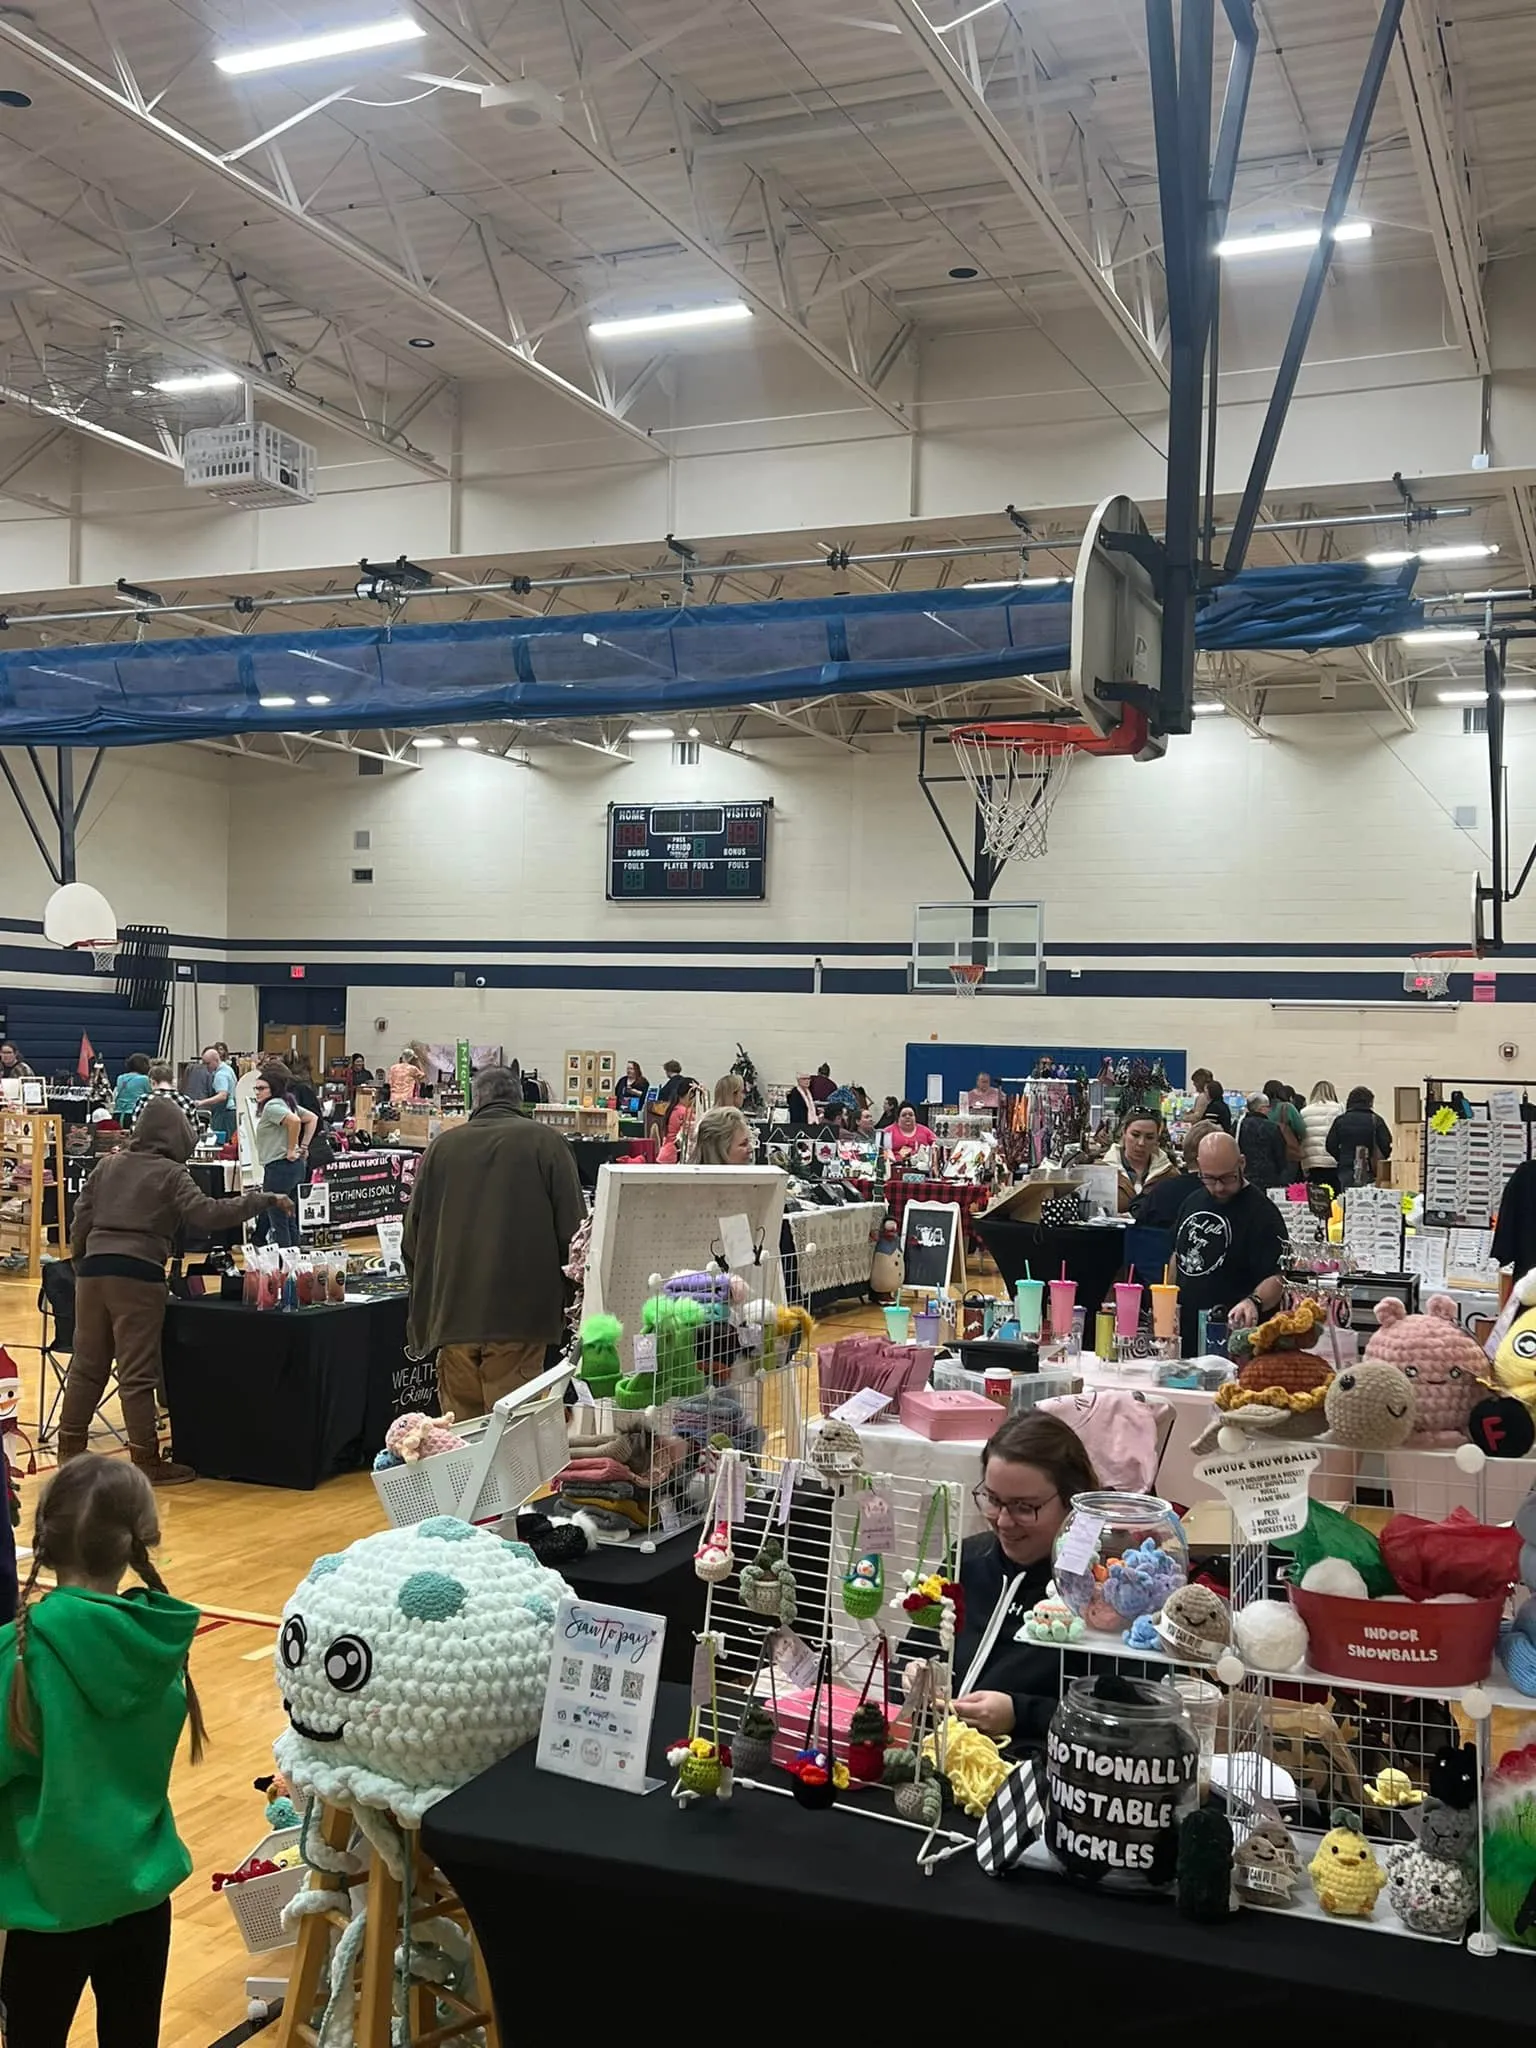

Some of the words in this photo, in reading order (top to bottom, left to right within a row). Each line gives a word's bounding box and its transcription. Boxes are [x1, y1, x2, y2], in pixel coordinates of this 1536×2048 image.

[618, 810, 645, 821] HOME
[726, 807, 762, 819] VISITOR
[627, 849, 650, 857] BONUS
[667, 843, 691, 851] PERIOD
[723, 848, 746, 856] BONUS
[623, 862, 645, 870] FOULS
[663, 862, 688, 870] PLAYER
[693, 862, 714, 870] FOULS
[728, 861, 750, 869] FOULS
[376, 1184, 396, 1196] ONLY
[1482, 1416, 1506, 1451] F
[1249, 1451, 1318, 1469] SNOWBALLS
[1363, 1626, 1420, 1643] INDOOR
[1347, 1643, 1438, 1662] SNOWBALLS
[1051, 1775, 1172, 1828] UNSTABLE
[1056, 1820, 1155, 1869] PICKLES
